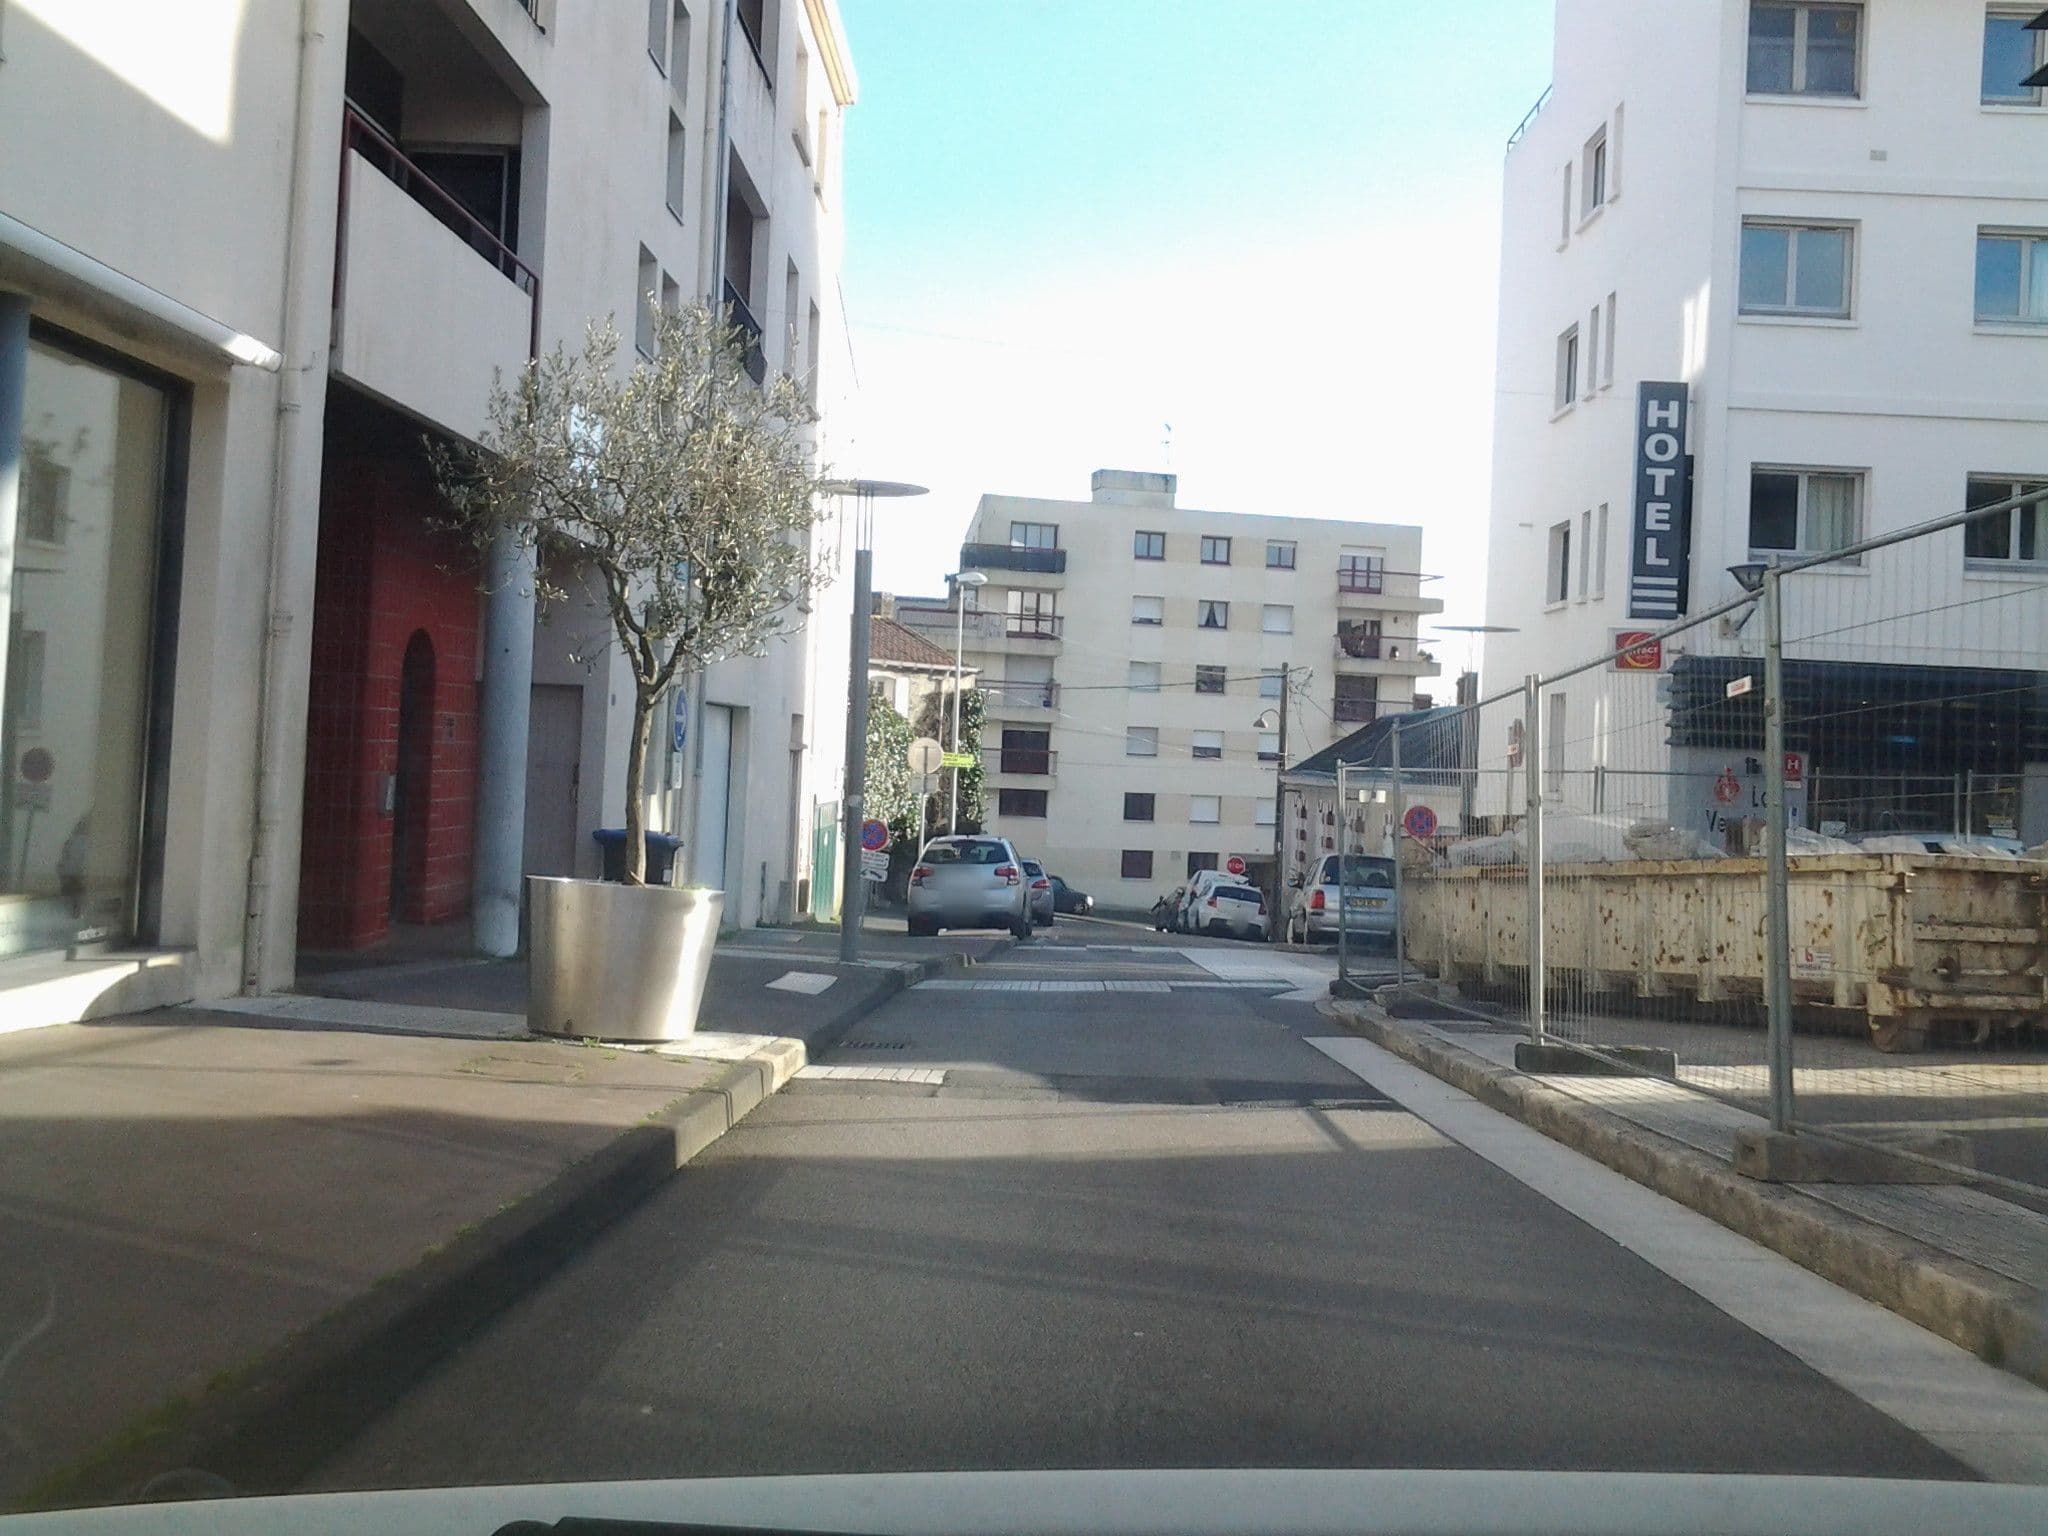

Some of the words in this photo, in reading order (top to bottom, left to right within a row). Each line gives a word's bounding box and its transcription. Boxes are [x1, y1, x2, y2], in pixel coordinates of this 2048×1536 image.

[1645, 400, 1679, 566] HOTEL
[1787, 759, 1799, 770] H
[1228, 861, 1244, 870] STOP
